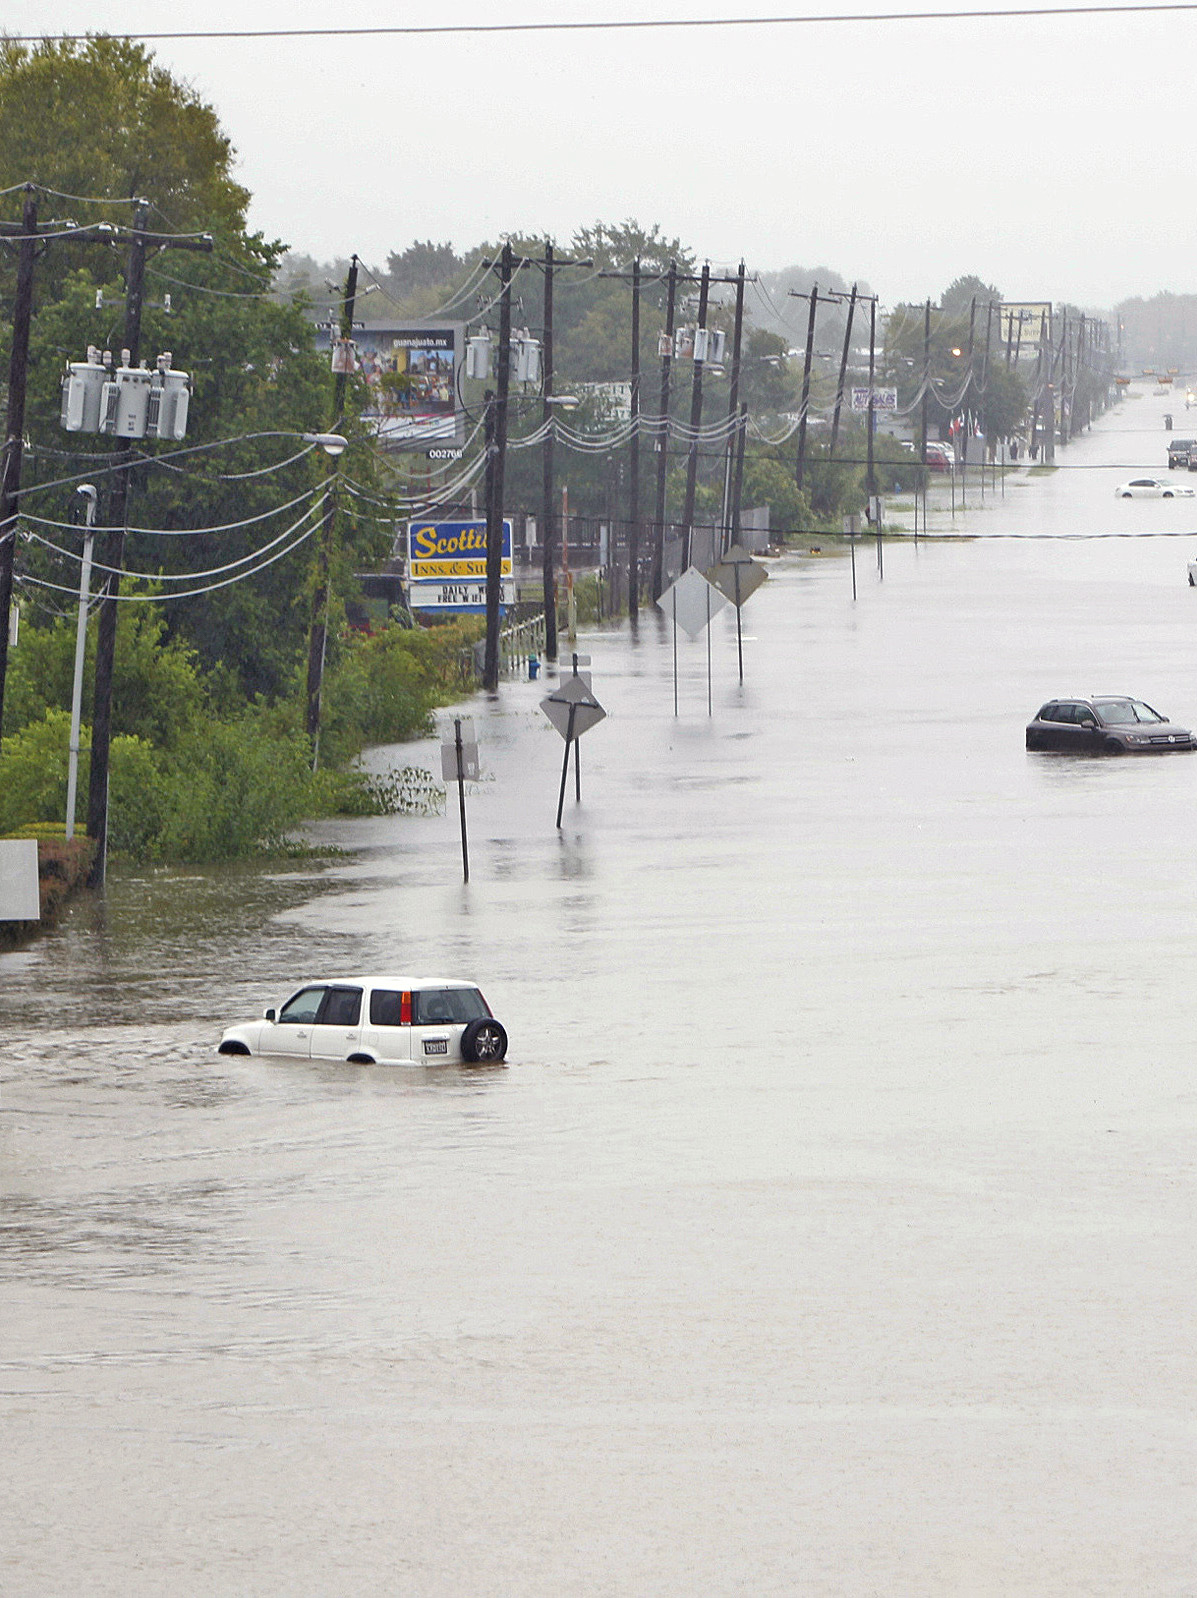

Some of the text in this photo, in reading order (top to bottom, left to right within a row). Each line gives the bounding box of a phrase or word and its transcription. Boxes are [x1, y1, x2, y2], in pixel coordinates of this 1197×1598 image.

[393, 337, 447, 347] guanajuato.mx
[449, 562, 462, 574] &
[442, 586, 468, 595] DAILY
